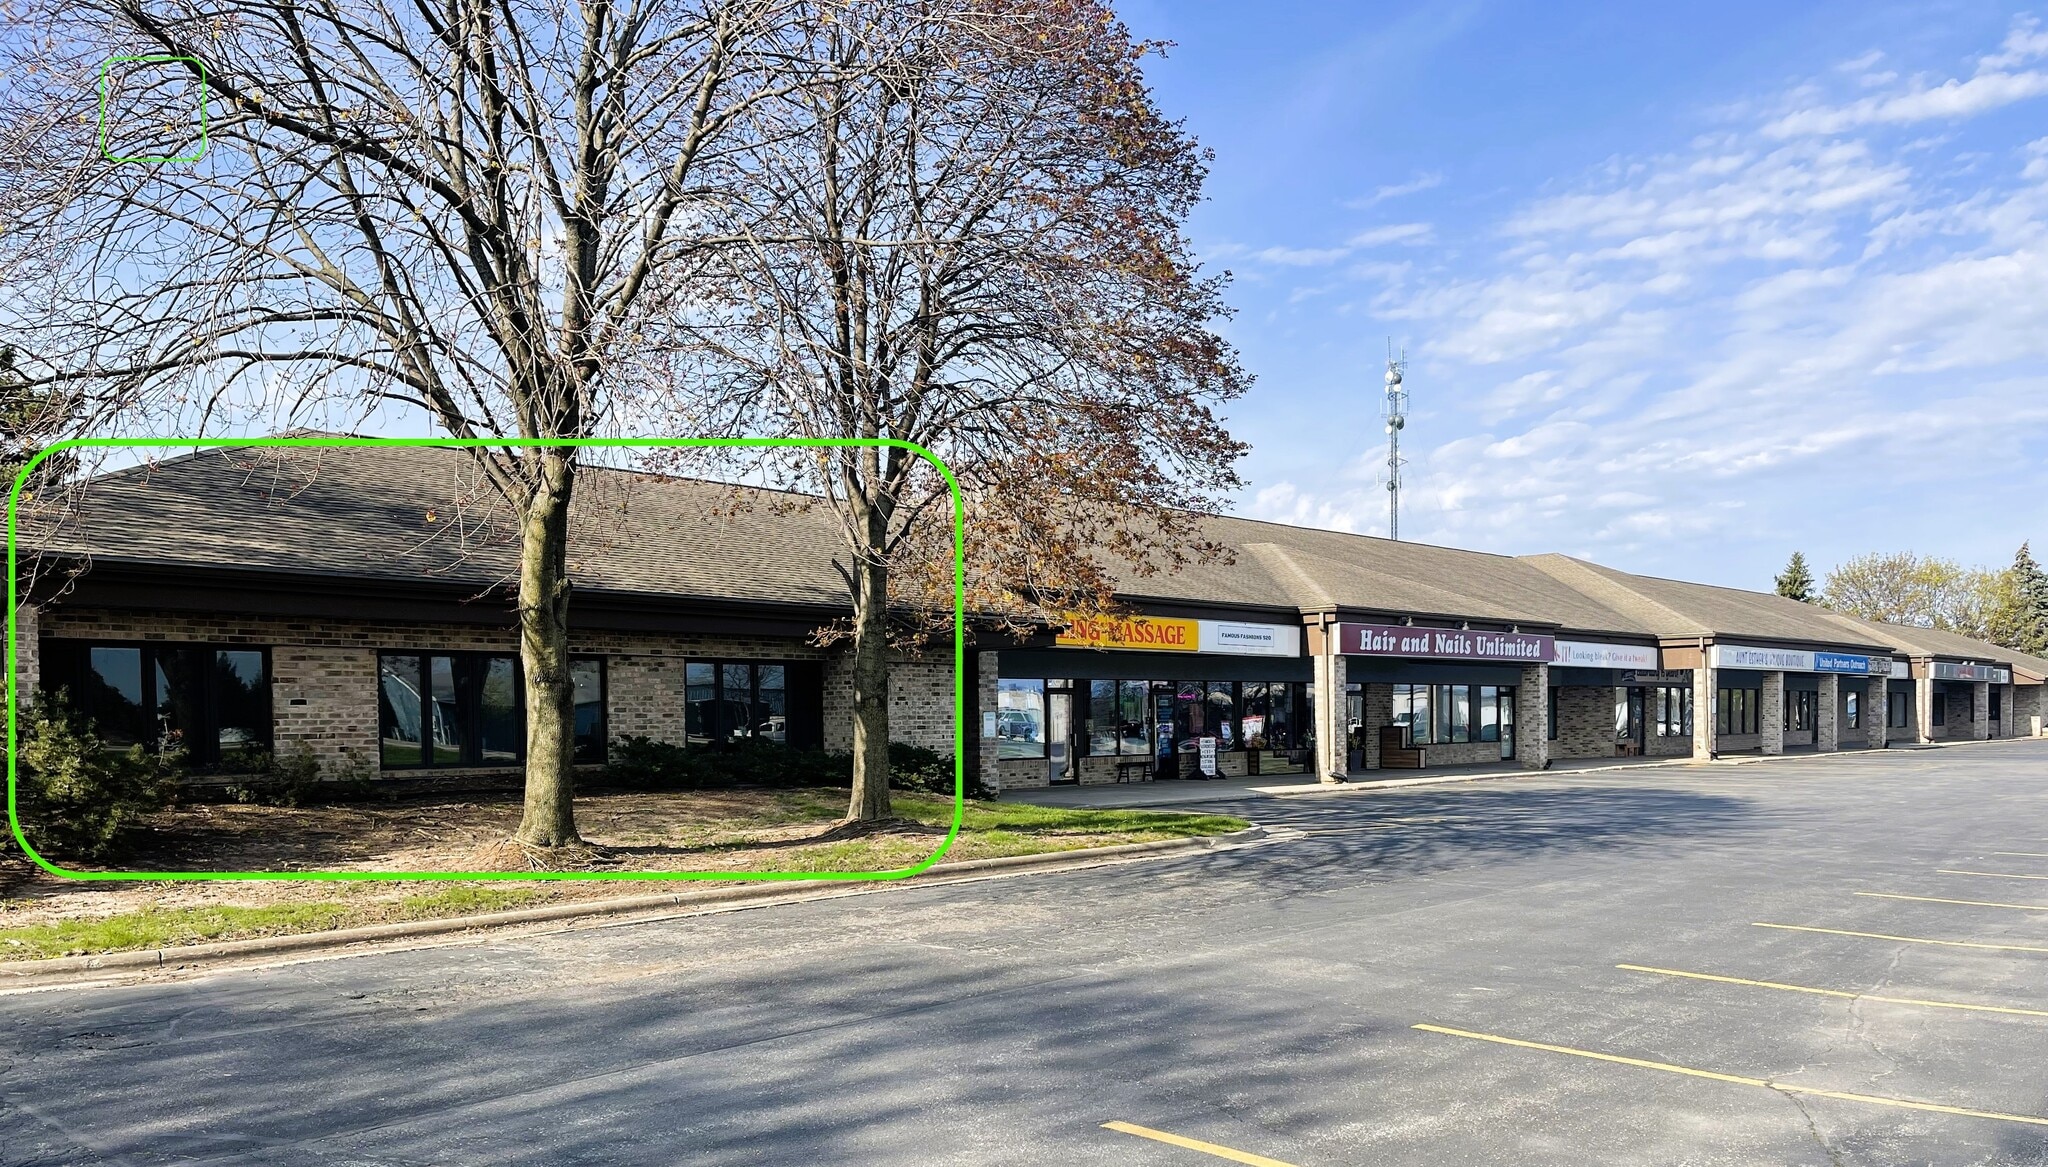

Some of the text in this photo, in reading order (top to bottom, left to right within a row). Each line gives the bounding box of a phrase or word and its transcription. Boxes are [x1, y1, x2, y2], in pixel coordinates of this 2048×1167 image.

[1057, 619, 1186, 645] ING MASSAGE
[1359, 629, 1541, 658] Hair and Nails Unlimited
[1572, 650, 1594, 662] Looking
[1611, 652, 1623, 662] Give
[1736, 651, 1748, 664] AUNT
[1819, 657, 1833, 668] United
[1833, 658, 1850, 669] Partners
[1850, 659, 1866, 670] Outreach
